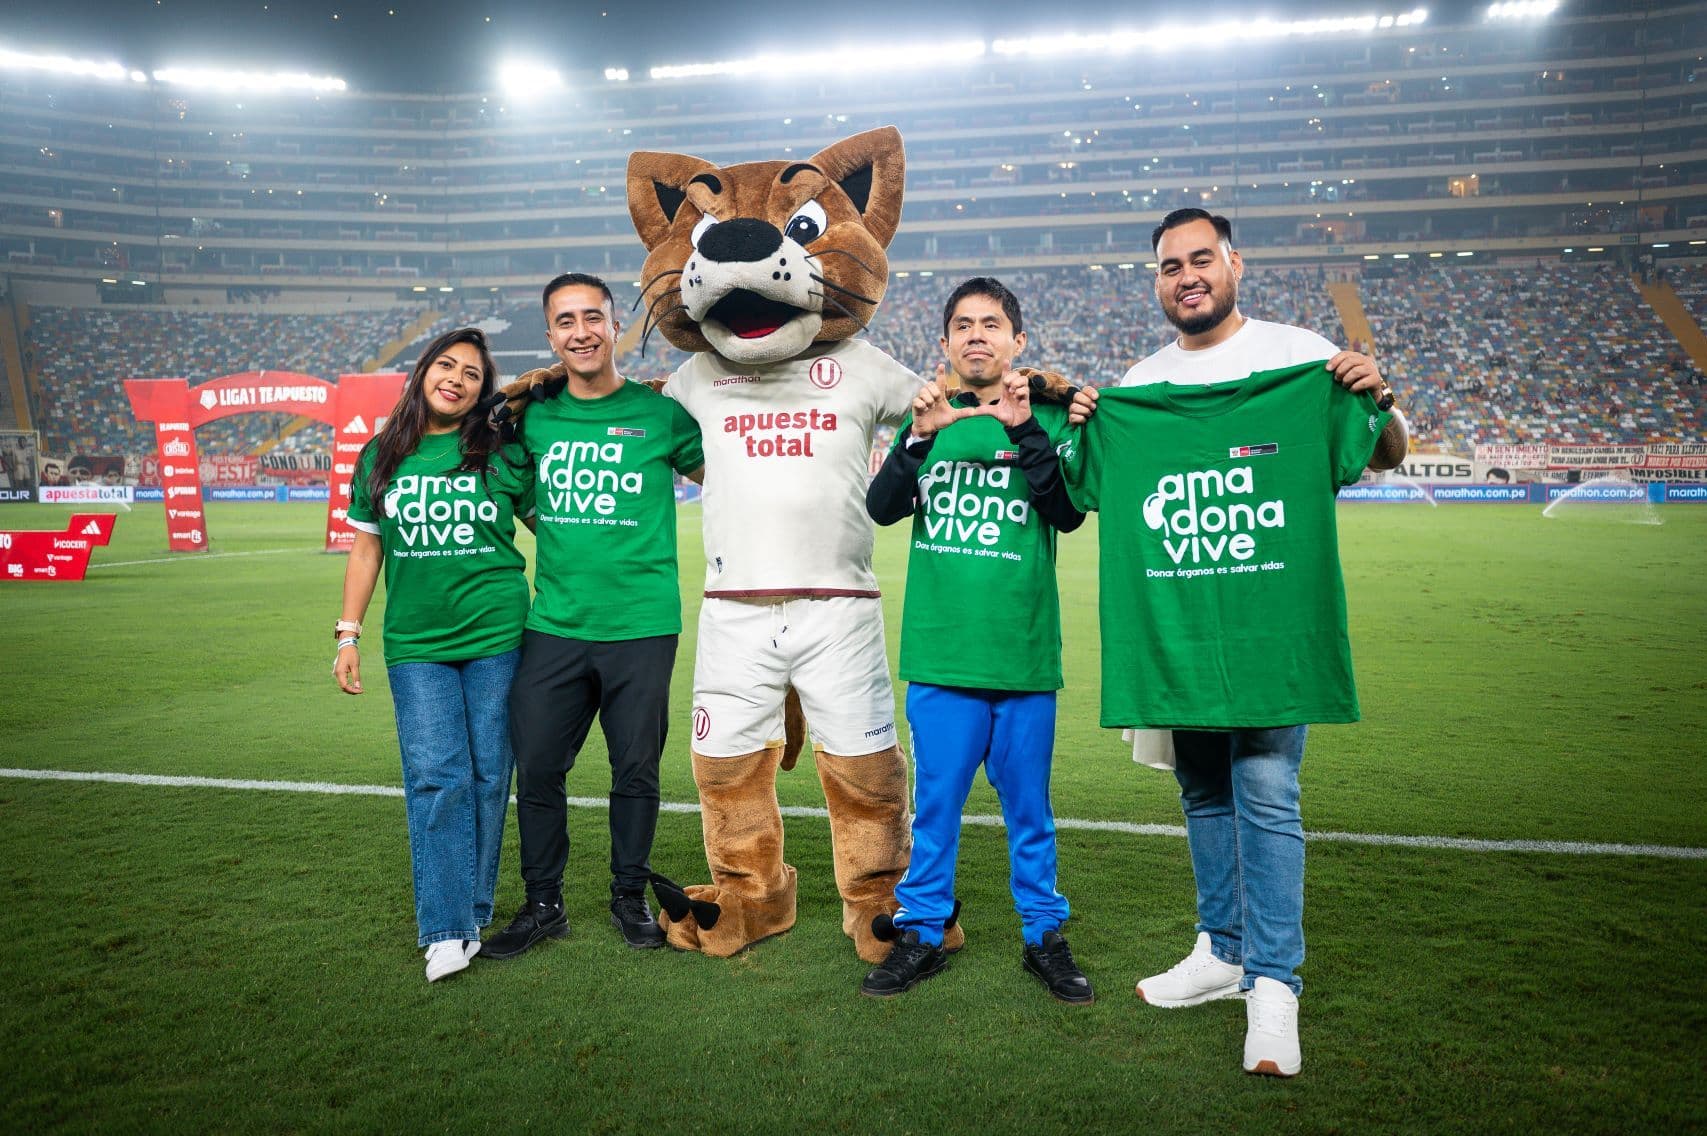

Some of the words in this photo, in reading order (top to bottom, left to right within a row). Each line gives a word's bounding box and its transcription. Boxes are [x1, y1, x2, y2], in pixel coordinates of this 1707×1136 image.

[713, 375, 761, 387] marathon
[724, 408, 837, 437] apuesta
[548, 441, 623, 463] ama
[746, 432, 814, 458] total
[552, 466, 642, 494] dona
[930, 460, 1010, 489] ama
[1393, 464, 1471, 477] ALTOS
[397, 475, 476, 494] ama
[1158, 466, 1253, 500] ama
[1435, 487, 1526, 499] marathon.com.pe
[1550, 488, 1644, 499] marathon.com.pe
[403, 497, 498, 523] dona
[548, 491, 616, 515] vive
[934, 488, 1029, 525] dona
[593, 516, 617, 525] salvar
[620, 518, 638, 527] vidas
[1170, 498, 1285, 535] dona
[398, 523, 475, 546] vive
[924, 516, 1000, 545] vive
[411, 550, 440, 558] órganos
[454, 548, 477, 556] salvar
[479, 545, 496, 553] vidas
[930, 544, 960, 555] órganos
[963, 547, 972, 555] es
[974, 547, 999, 557] salvar
[1001, 551, 1022, 561] vidas
[1163, 533, 1255, 564] vive
[1147, 568, 1174, 577] Donar
[1176, 566, 1214, 579] órganos
[1230, 563, 1258, 574] salvar
[1260, 561, 1285, 570] vidas
